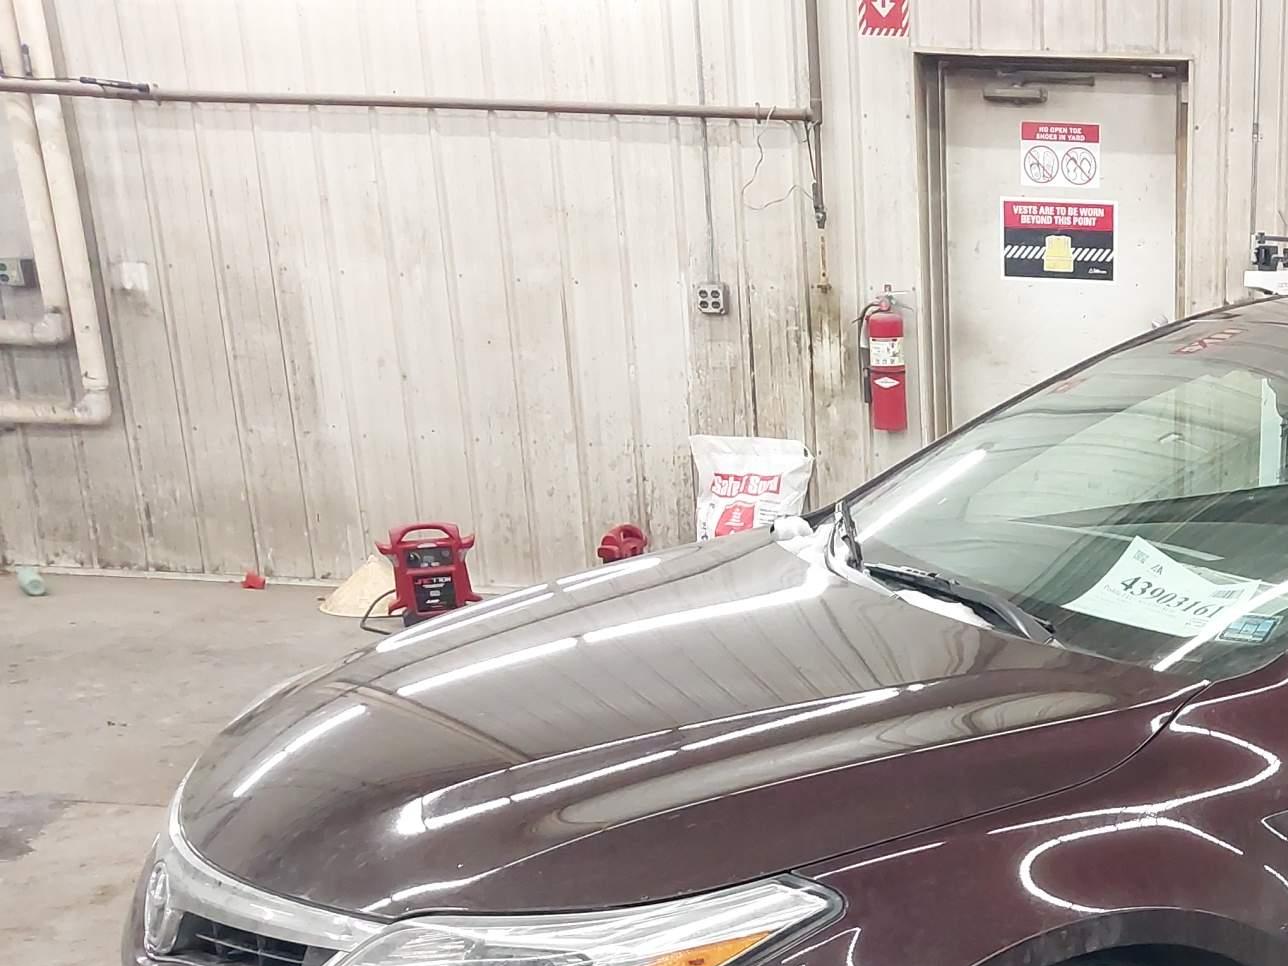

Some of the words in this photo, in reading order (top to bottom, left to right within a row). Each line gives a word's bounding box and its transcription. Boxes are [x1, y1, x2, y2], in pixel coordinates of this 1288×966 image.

[1013, 205, 1038, 215] VESTS
[1039, 206, 1055, 216] ARE
[1056, 207, 1066, 216] TO
[1068, 207, 1079, 216] BE
[1079, 208, 1105, 217] WORN
[1021, 214, 1053, 225] BEYOND
[1054, 216, 1072, 226] THIS
[1073, 217, 1097, 227] POINT
[1120, 576, 1224, 619] 43903161
